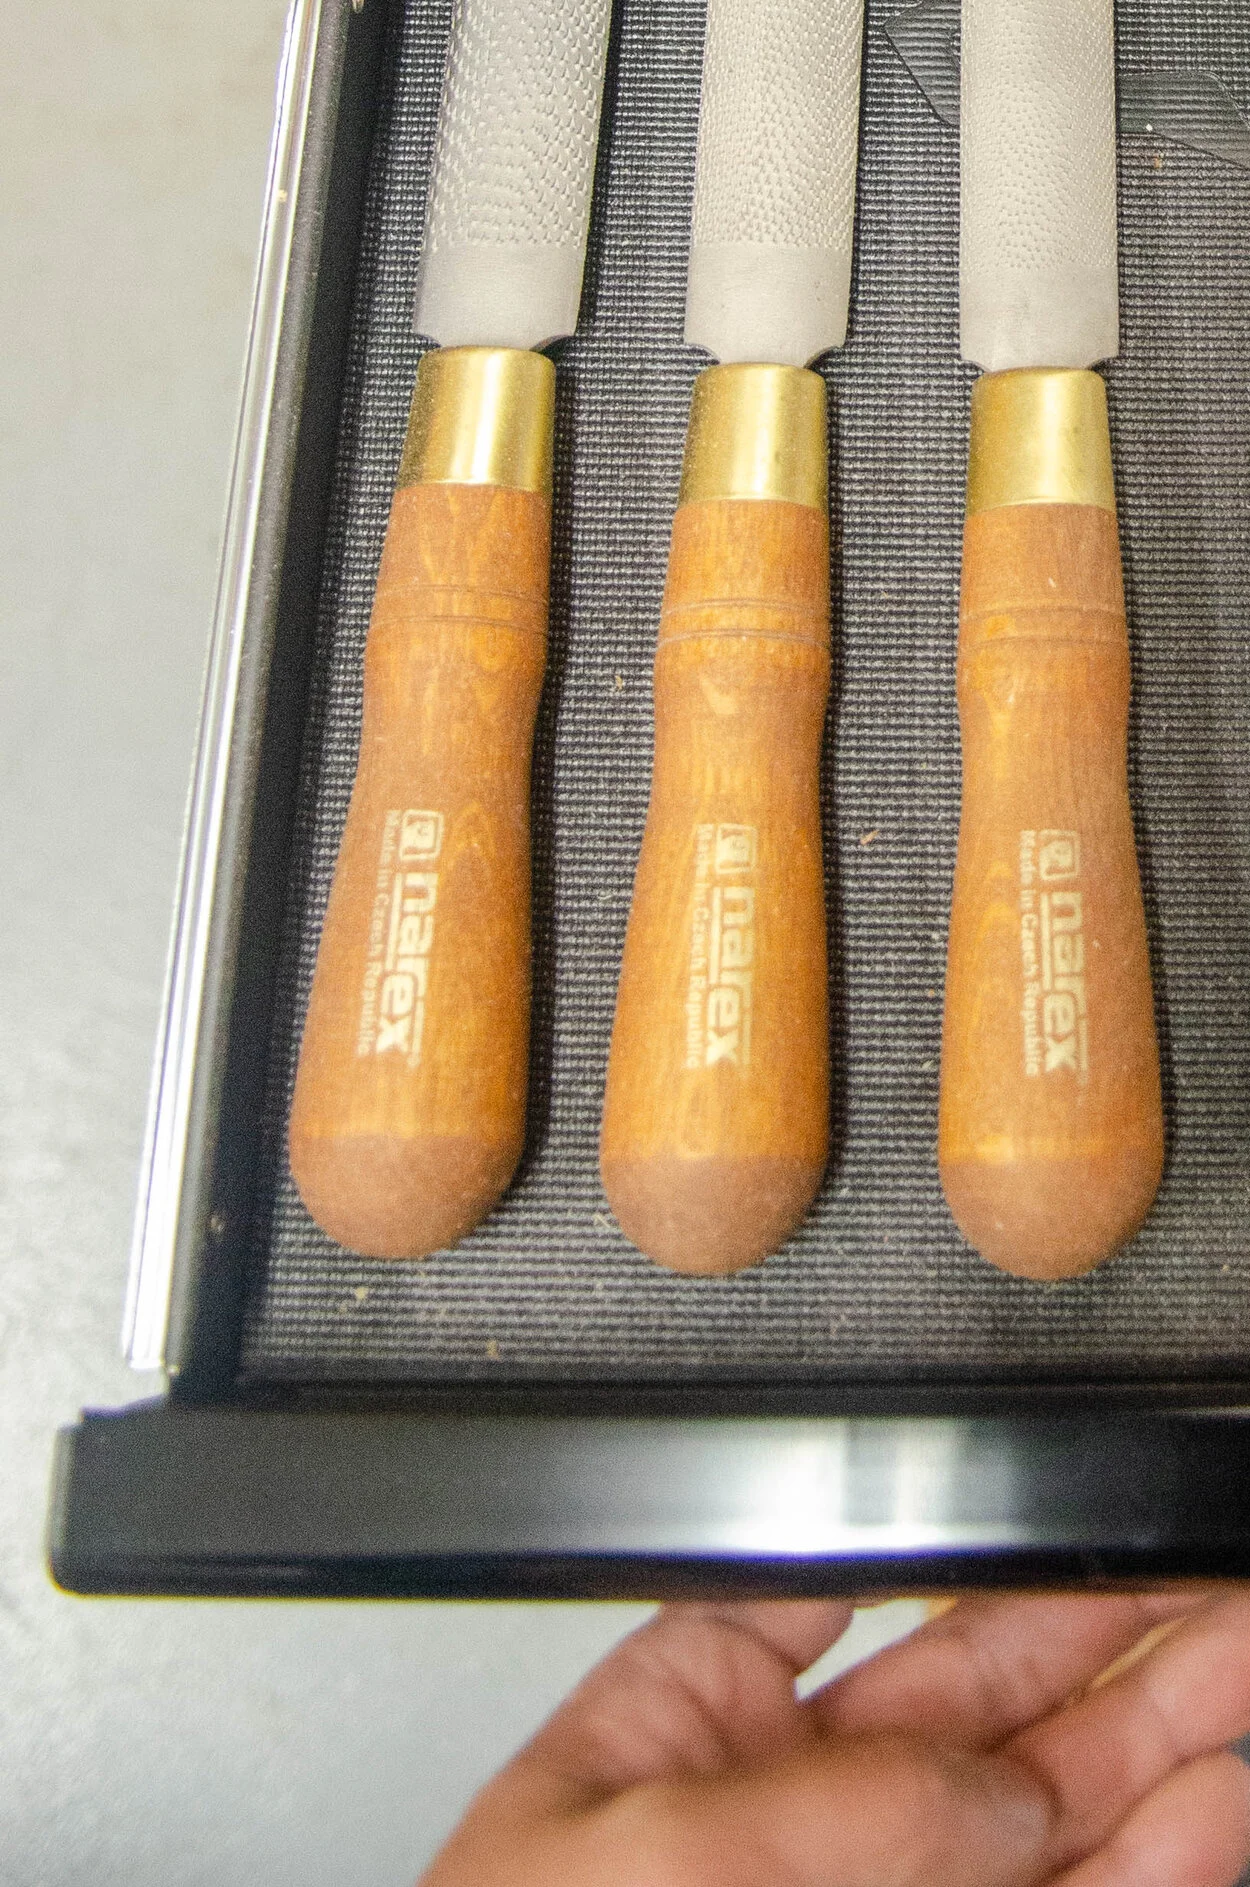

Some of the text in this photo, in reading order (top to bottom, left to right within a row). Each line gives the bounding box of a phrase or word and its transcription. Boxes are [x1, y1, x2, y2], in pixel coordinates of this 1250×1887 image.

[380, 808, 402, 867] Made
[695, 823, 715, 878] Made
[1019, 829, 1037, 885] Made
[367, 893, 389, 958] Czech
[376, 872, 440, 1057] narex
[689, 906, 709, 971] Czech
[1021, 913, 1039, 978] Czech
[357, 961, 381, 1057] Republic
[705, 886, 756, 1069] narex
[1040, 892, 1088, 1078] narex
[683, 976, 706, 1070] Republic
[1020, 982, 1041, 1078] Republic
